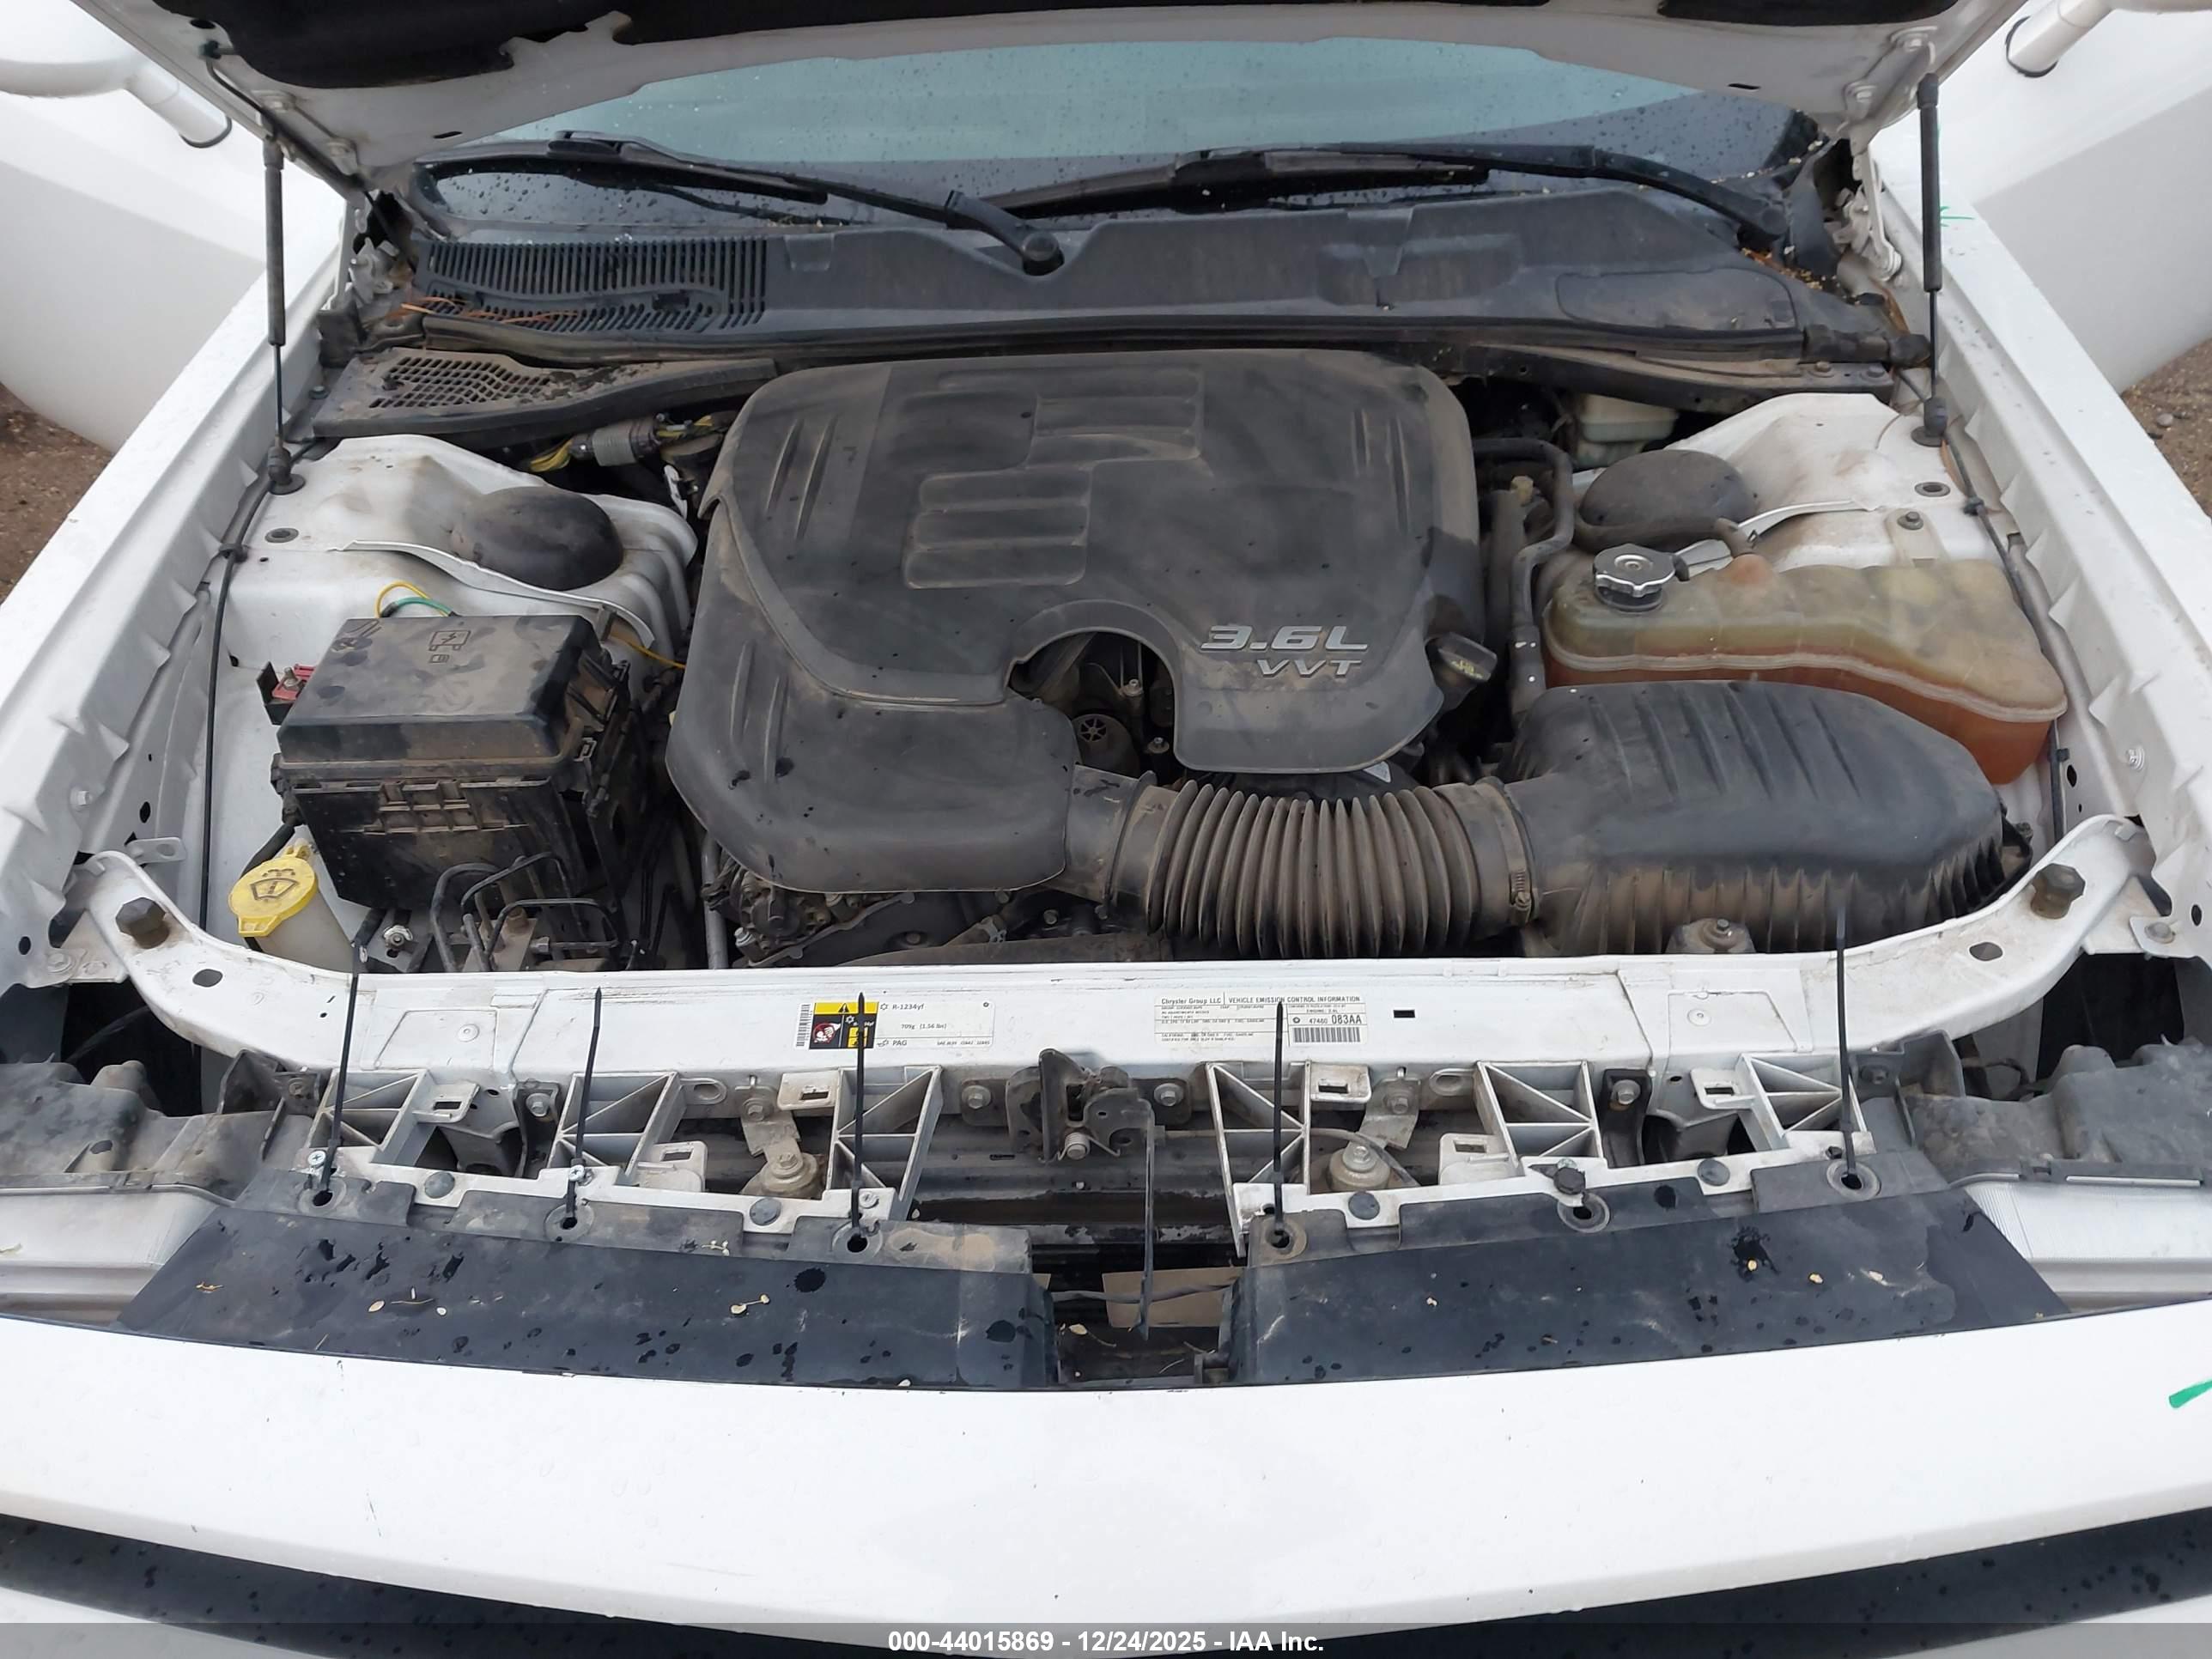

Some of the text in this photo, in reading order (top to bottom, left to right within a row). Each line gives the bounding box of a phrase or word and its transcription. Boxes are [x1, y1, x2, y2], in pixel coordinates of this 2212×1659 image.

[1200, 625, 1368, 651] 3.6L
[1256, 659, 1362, 677] VVT
[1331, 1014, 1362, 1024] 083AA
